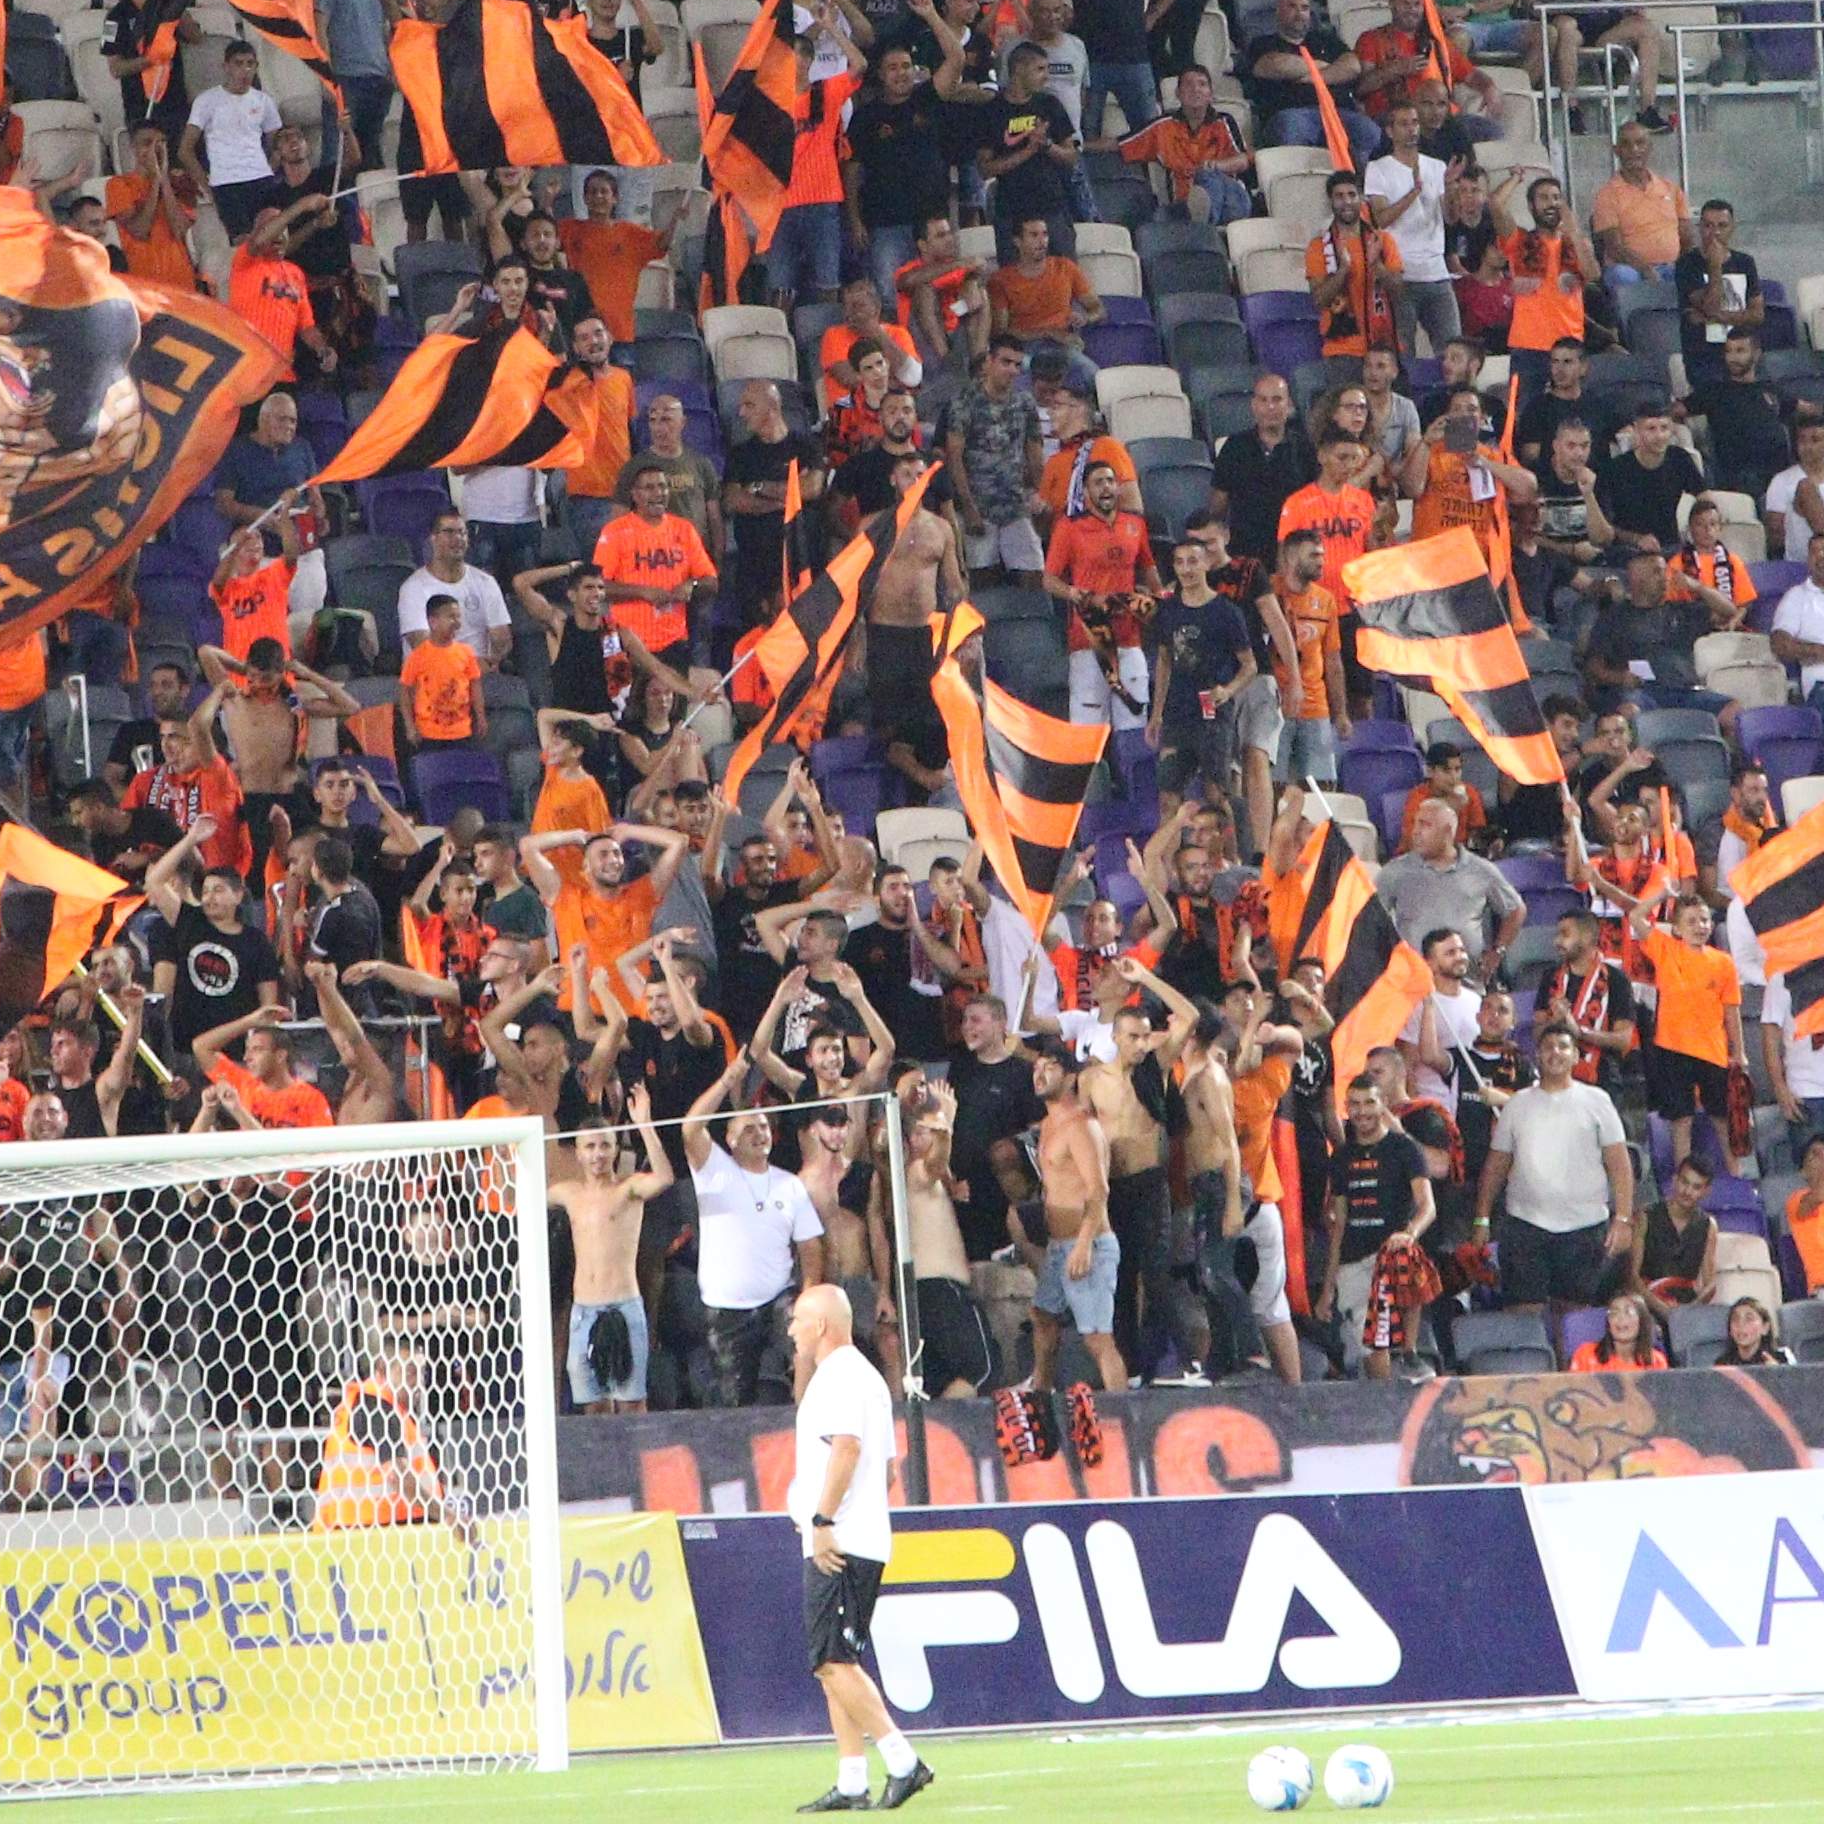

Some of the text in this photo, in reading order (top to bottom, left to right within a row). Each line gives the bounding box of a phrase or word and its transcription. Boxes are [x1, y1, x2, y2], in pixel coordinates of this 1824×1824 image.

[1008, 114, 1038, 133] NIKE
[2, 1564, 388, 1664] KOPELL
[869, 1513, 1403, 1713] FILA
[25, 1675, 229, 1740] group
